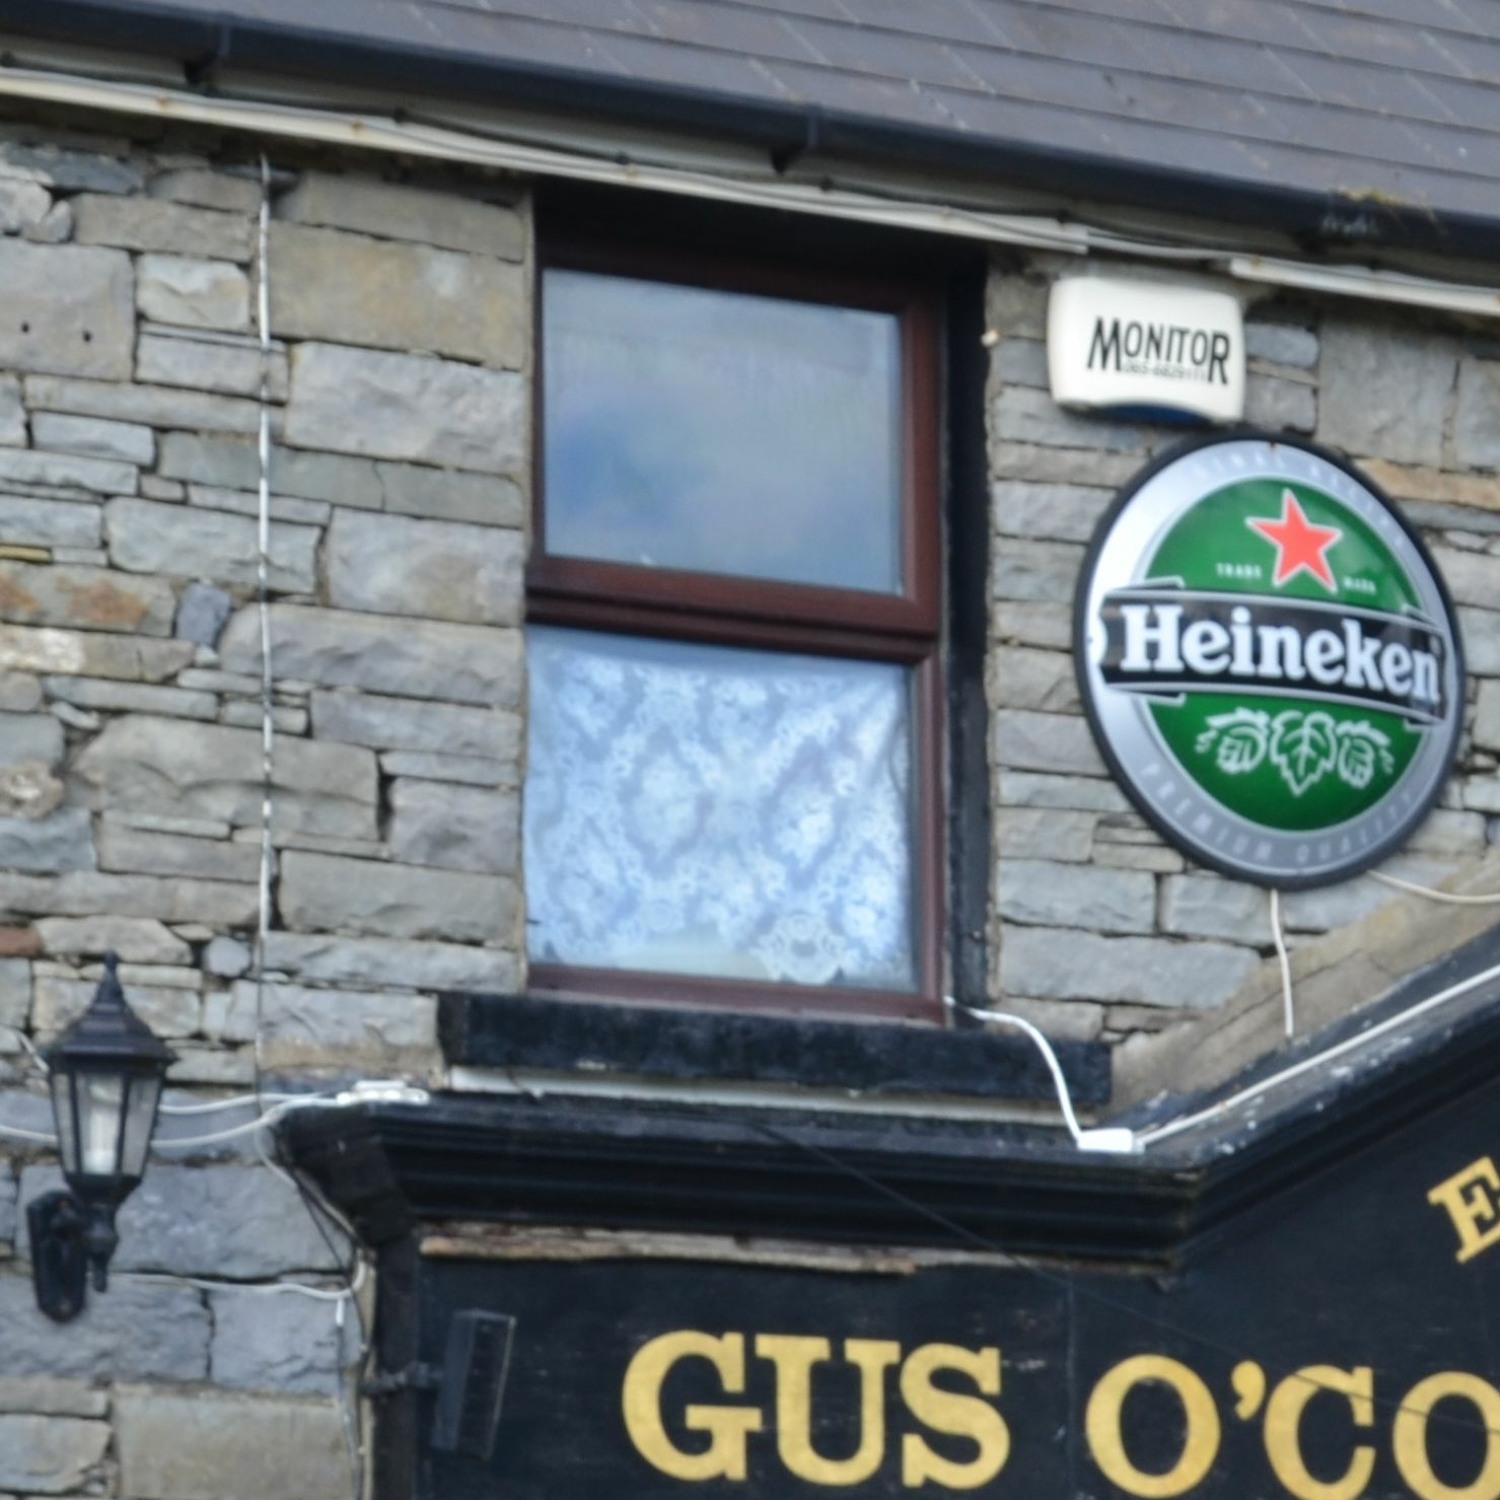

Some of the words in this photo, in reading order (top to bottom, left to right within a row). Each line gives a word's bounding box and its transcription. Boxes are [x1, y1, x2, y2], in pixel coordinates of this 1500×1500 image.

[1087, 316, 1230, 385] MONITOR
[1119, 604, 1441, 702] Heineken
[621, 1329, 1011, 1490] GUS
